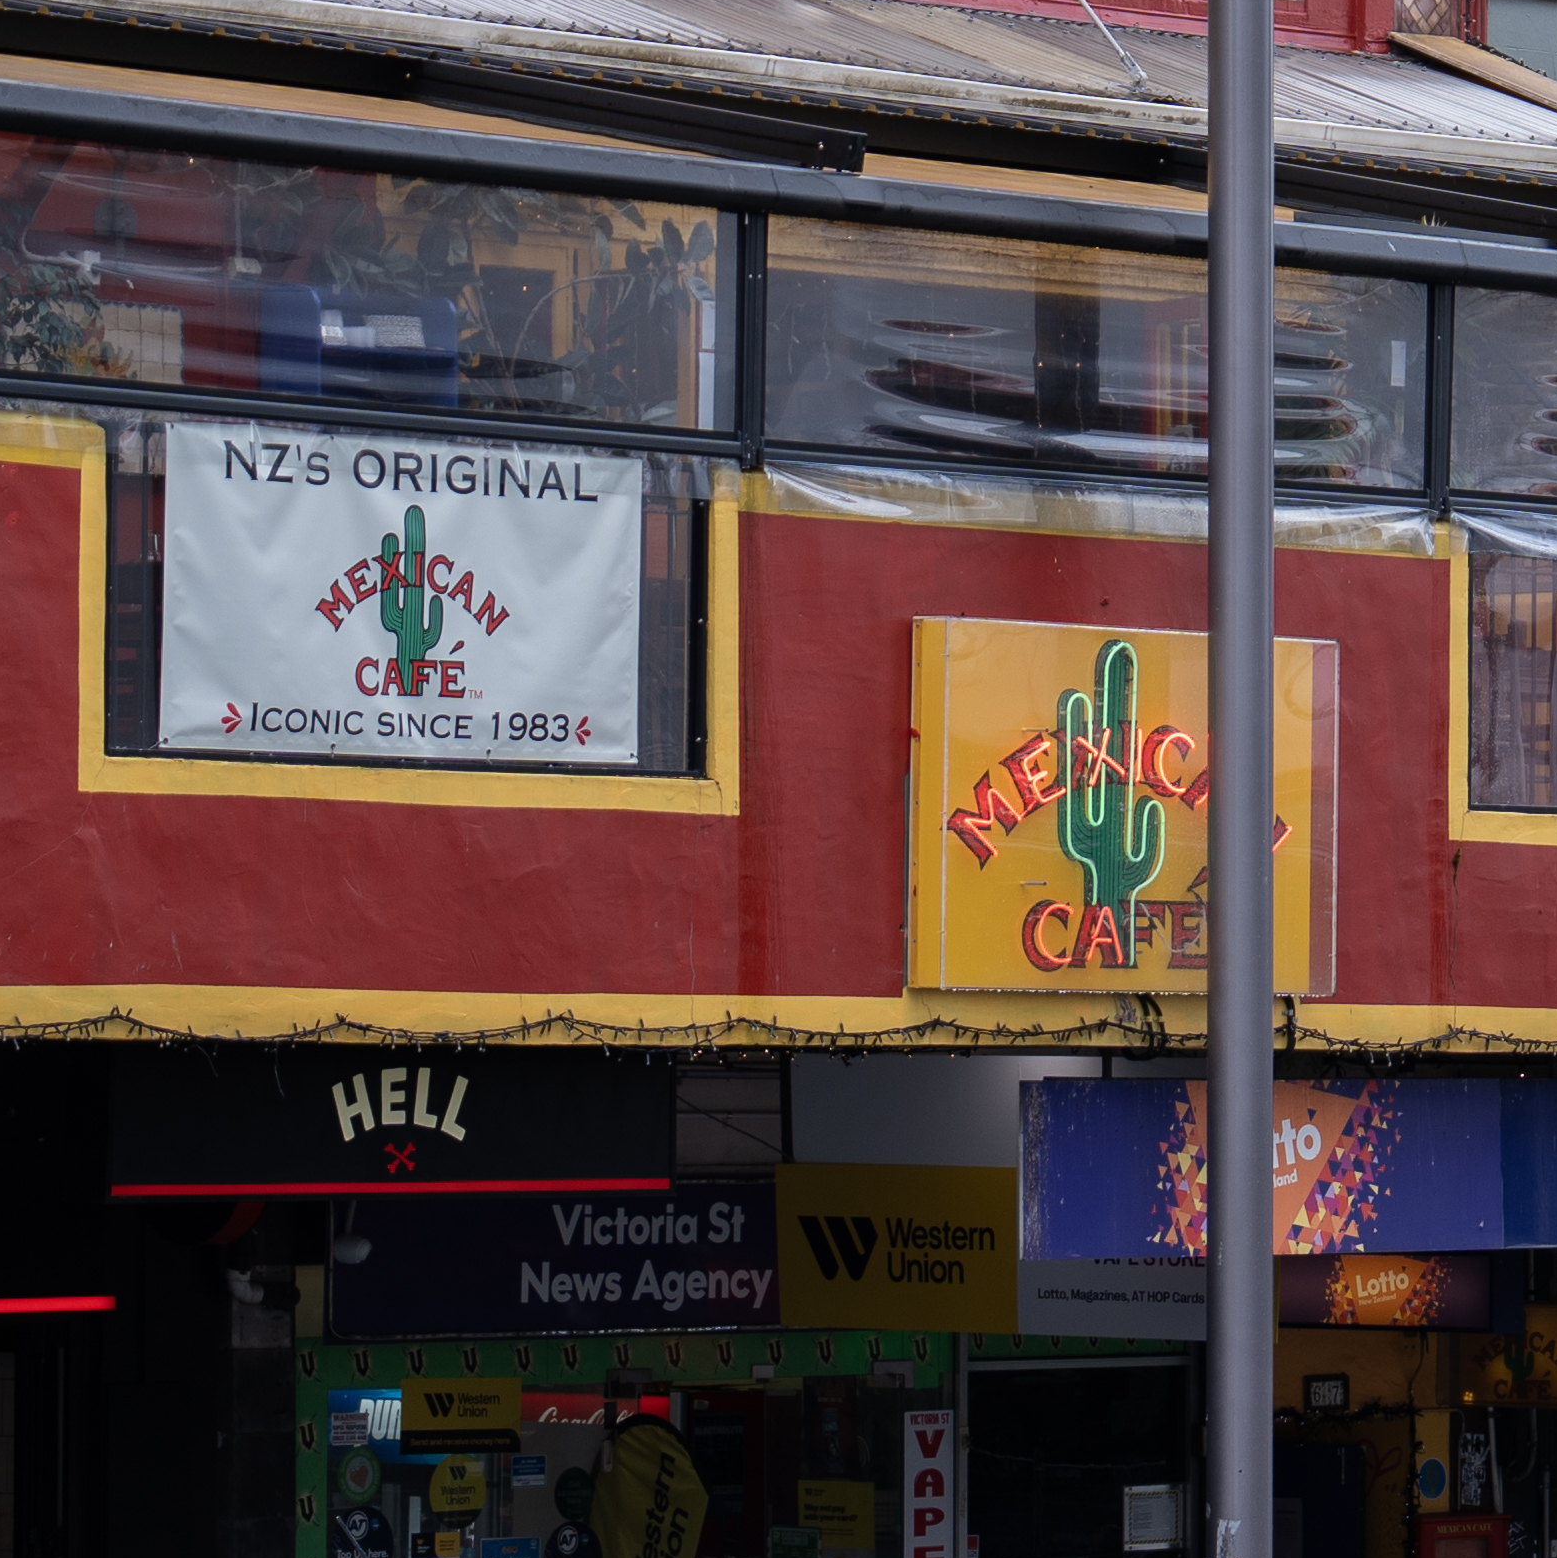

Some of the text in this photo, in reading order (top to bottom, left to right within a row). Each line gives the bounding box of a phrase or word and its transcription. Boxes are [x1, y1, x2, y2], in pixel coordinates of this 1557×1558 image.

[352, 447, 599, 503] ORIGINAL
[314, 551, 511, 637] MEXICAN
[354, 640, 467, 699] CAFÉ
[249, 701, 570, 743] ICONIC SINCE 1983
[330, 1065, 471, 1143] HELL
[550, 1200, 747, 1246] Victoria St
[883, 1217, 997, 1255] Western
[519, 1261, 774, 1313] News Agency
[885, 1249, 968, 1286] Union
[1354, 1268, 1411, 1300] Lotto
[1036, 1287, 1207, 1308] Lotto, Magazines, Cards
[457, 1392, 501, 1405] Western
[457, 1405, 489, 1419] Union
